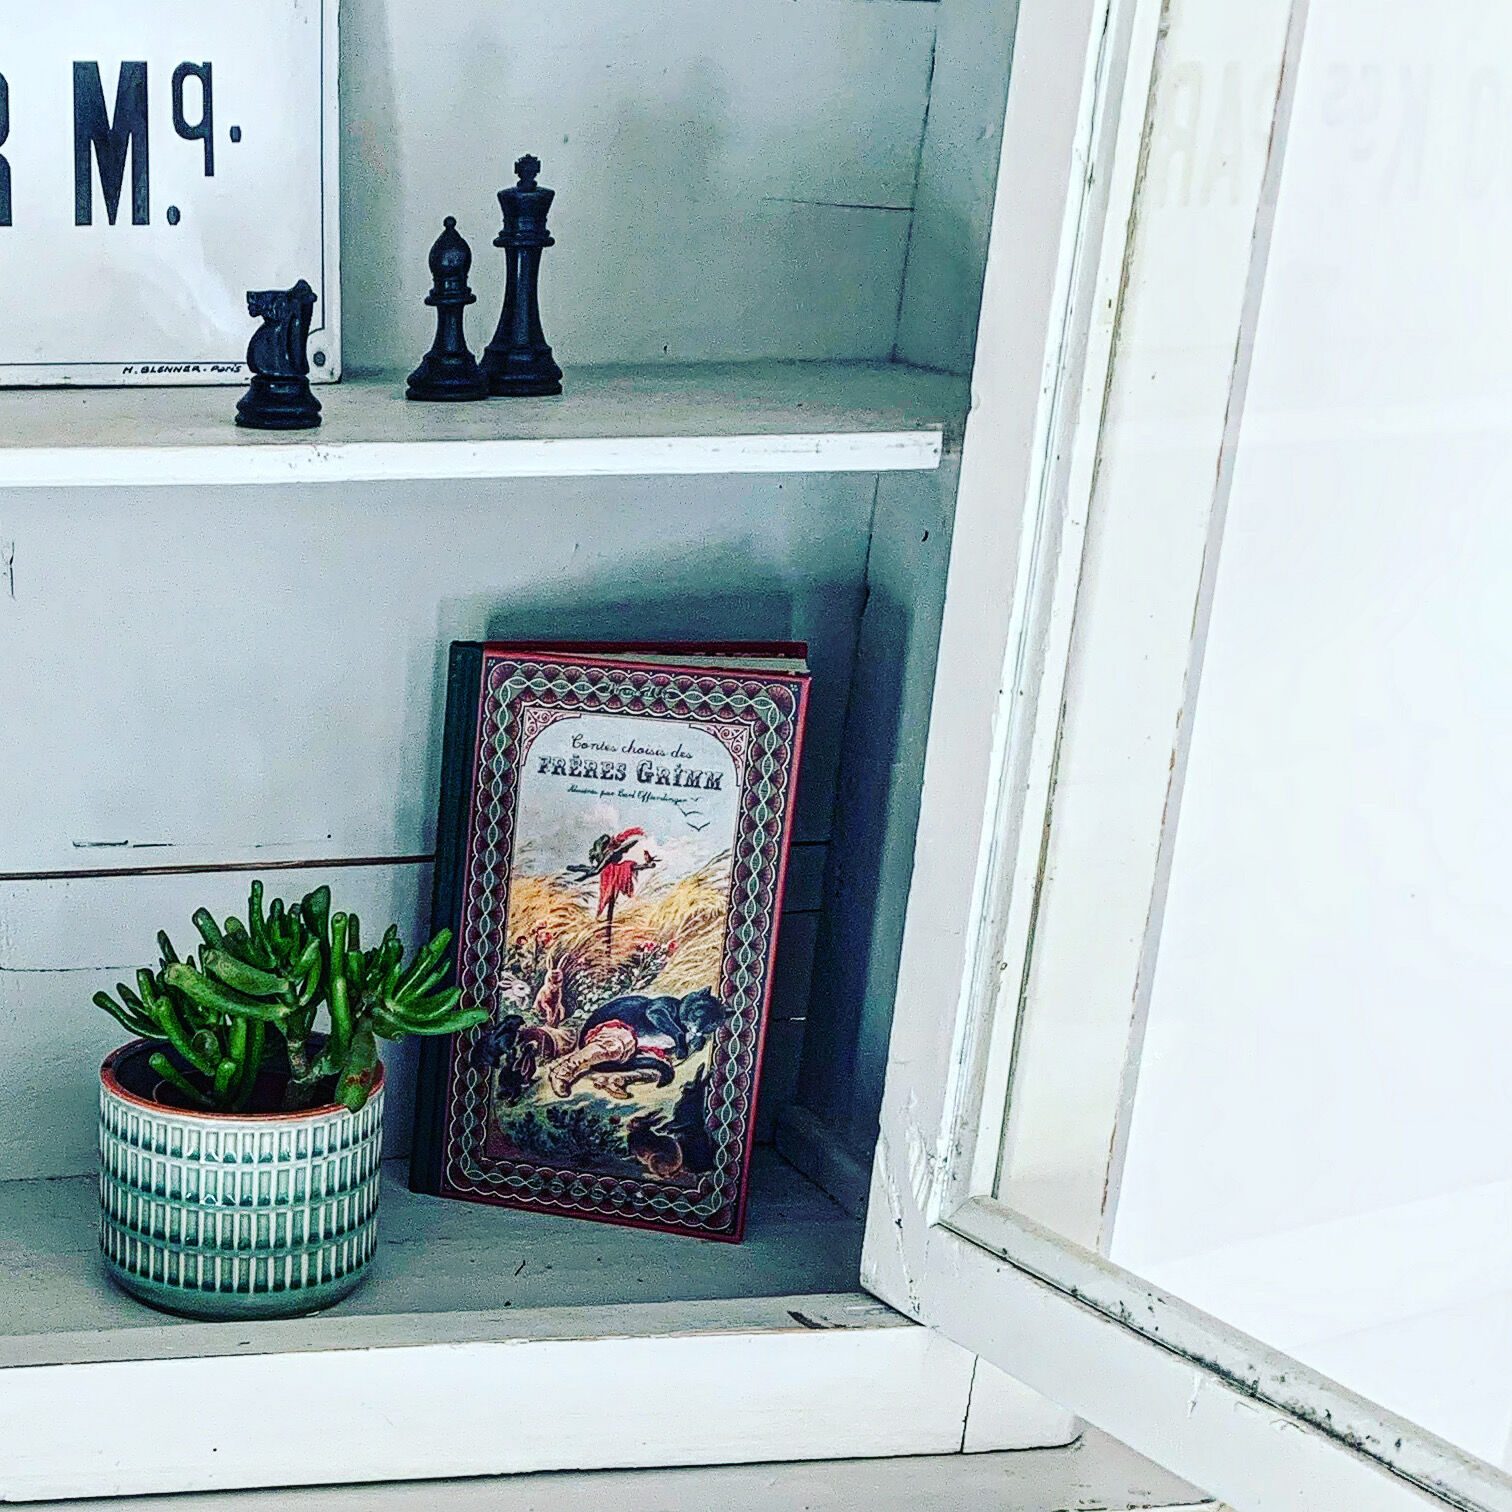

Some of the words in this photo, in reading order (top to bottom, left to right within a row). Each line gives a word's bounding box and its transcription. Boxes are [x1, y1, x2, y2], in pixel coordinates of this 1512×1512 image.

[571, 733, 617, 752] Contes
[621, 739, 666, 757] choisis
[670, 743, 693, 759] des
